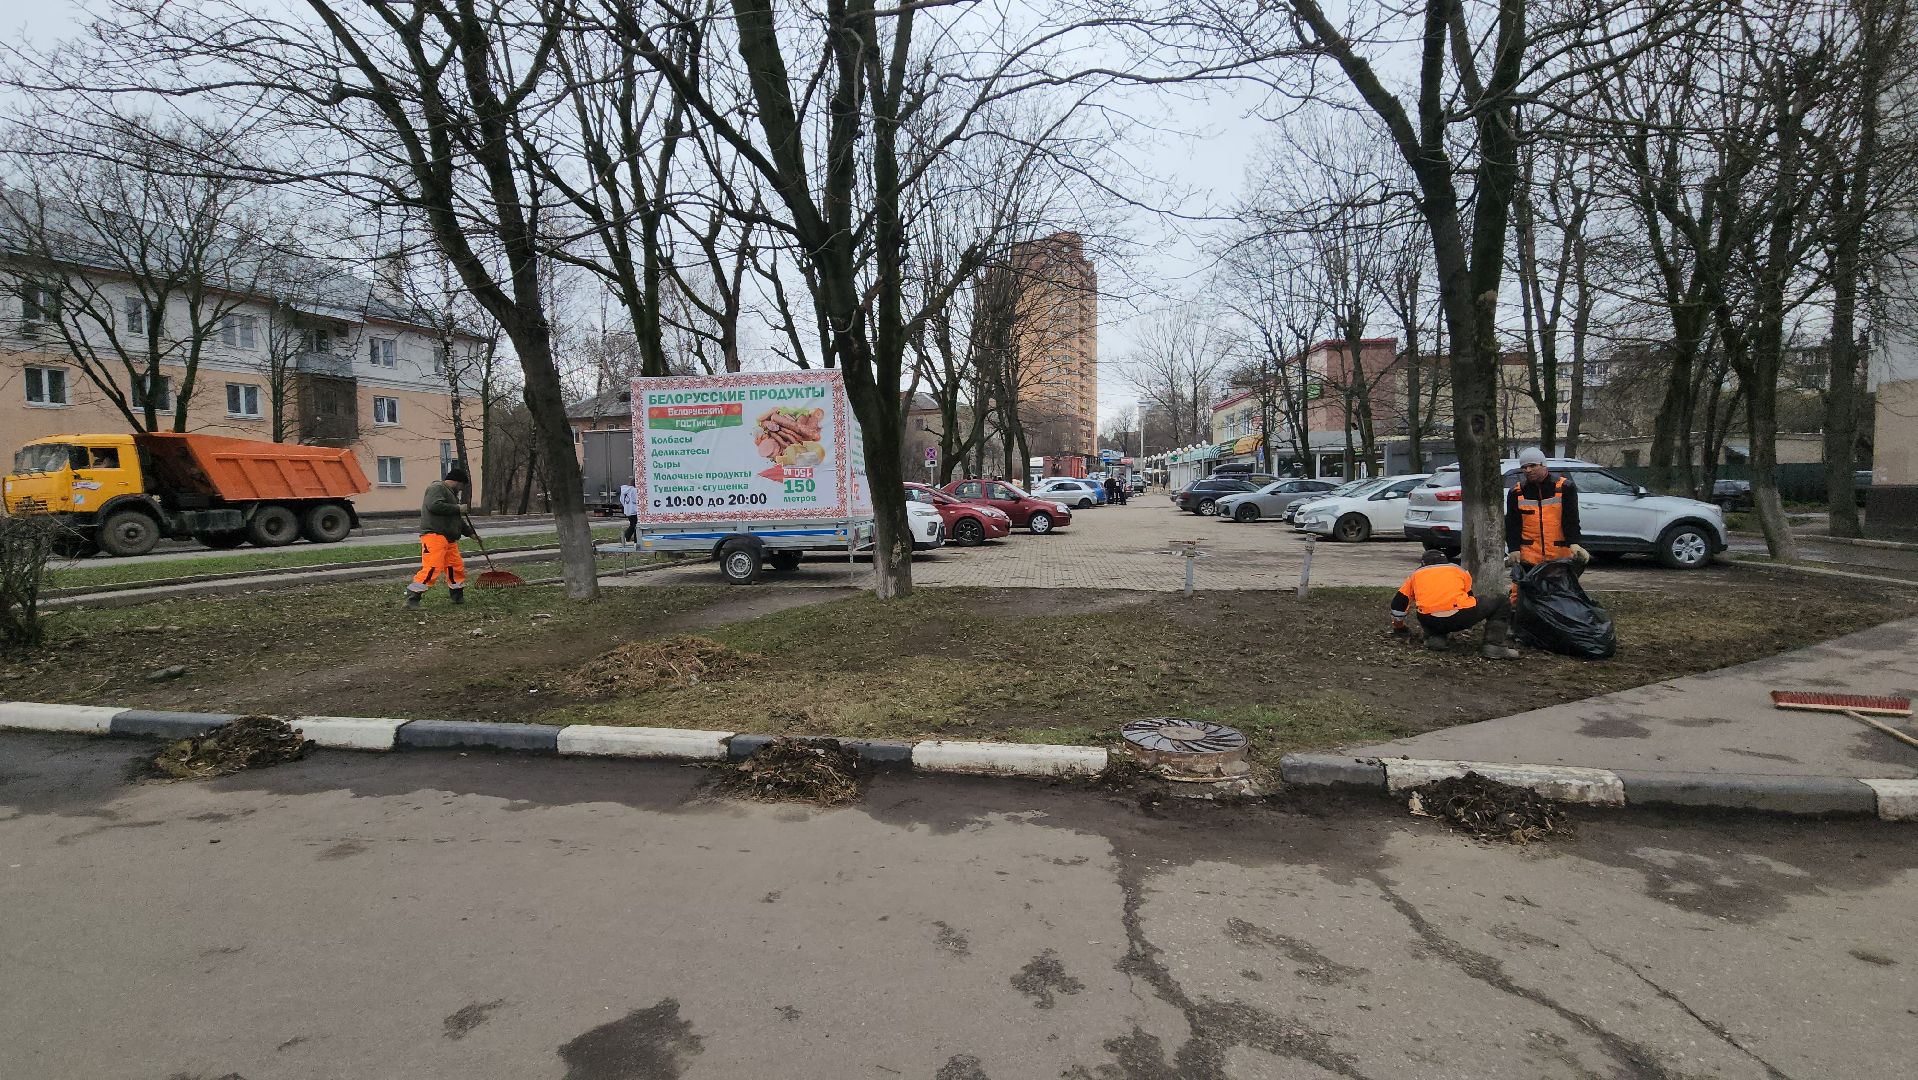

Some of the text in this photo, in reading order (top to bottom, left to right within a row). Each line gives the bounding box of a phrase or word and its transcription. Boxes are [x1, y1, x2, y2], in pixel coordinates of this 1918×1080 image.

[648, 386, 825, 405] БЕЛОРУССКИЕ ПРОДУКТЫ
[651, 436, 692, 444] Колбасы
[651, 448, 710, 457] Деликатесы
[653, 461, 680, 469] Сыры
[653, 471, 752, 480] Молочные продукты
[654, 485, 695, 493] Тушенка
[702, 483, 749, 492] сгущенка
[784, 479, 816, 493] 150
[653, 493, 768, 507] с 10:00 до 20:00
[783, 495, 817, 503] метров
